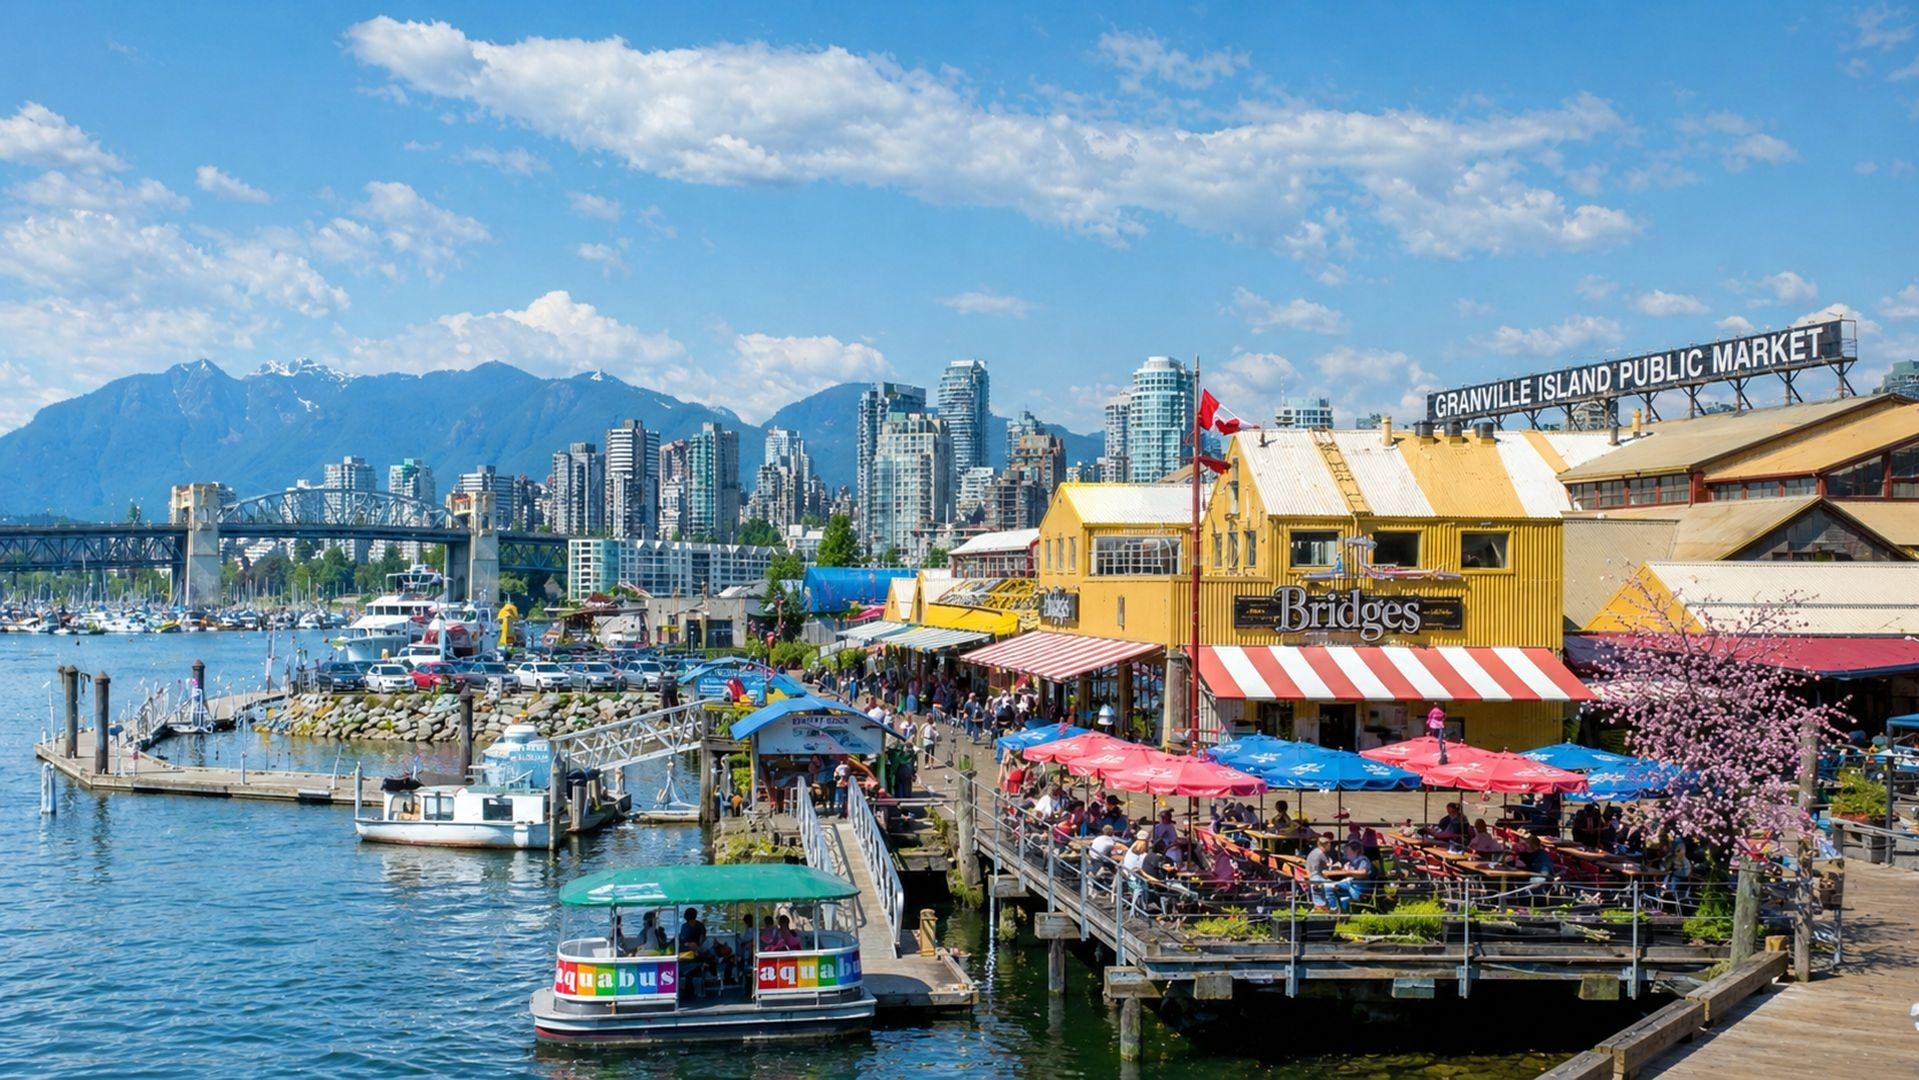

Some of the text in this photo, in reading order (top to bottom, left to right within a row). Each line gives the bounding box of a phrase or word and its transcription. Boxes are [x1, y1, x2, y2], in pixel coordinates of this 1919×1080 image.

[1435, 326, 1824, 418] GRANVILLE ISLAND PUBLIC MARKET
[1274, 585, 1421, 642] Bridges
